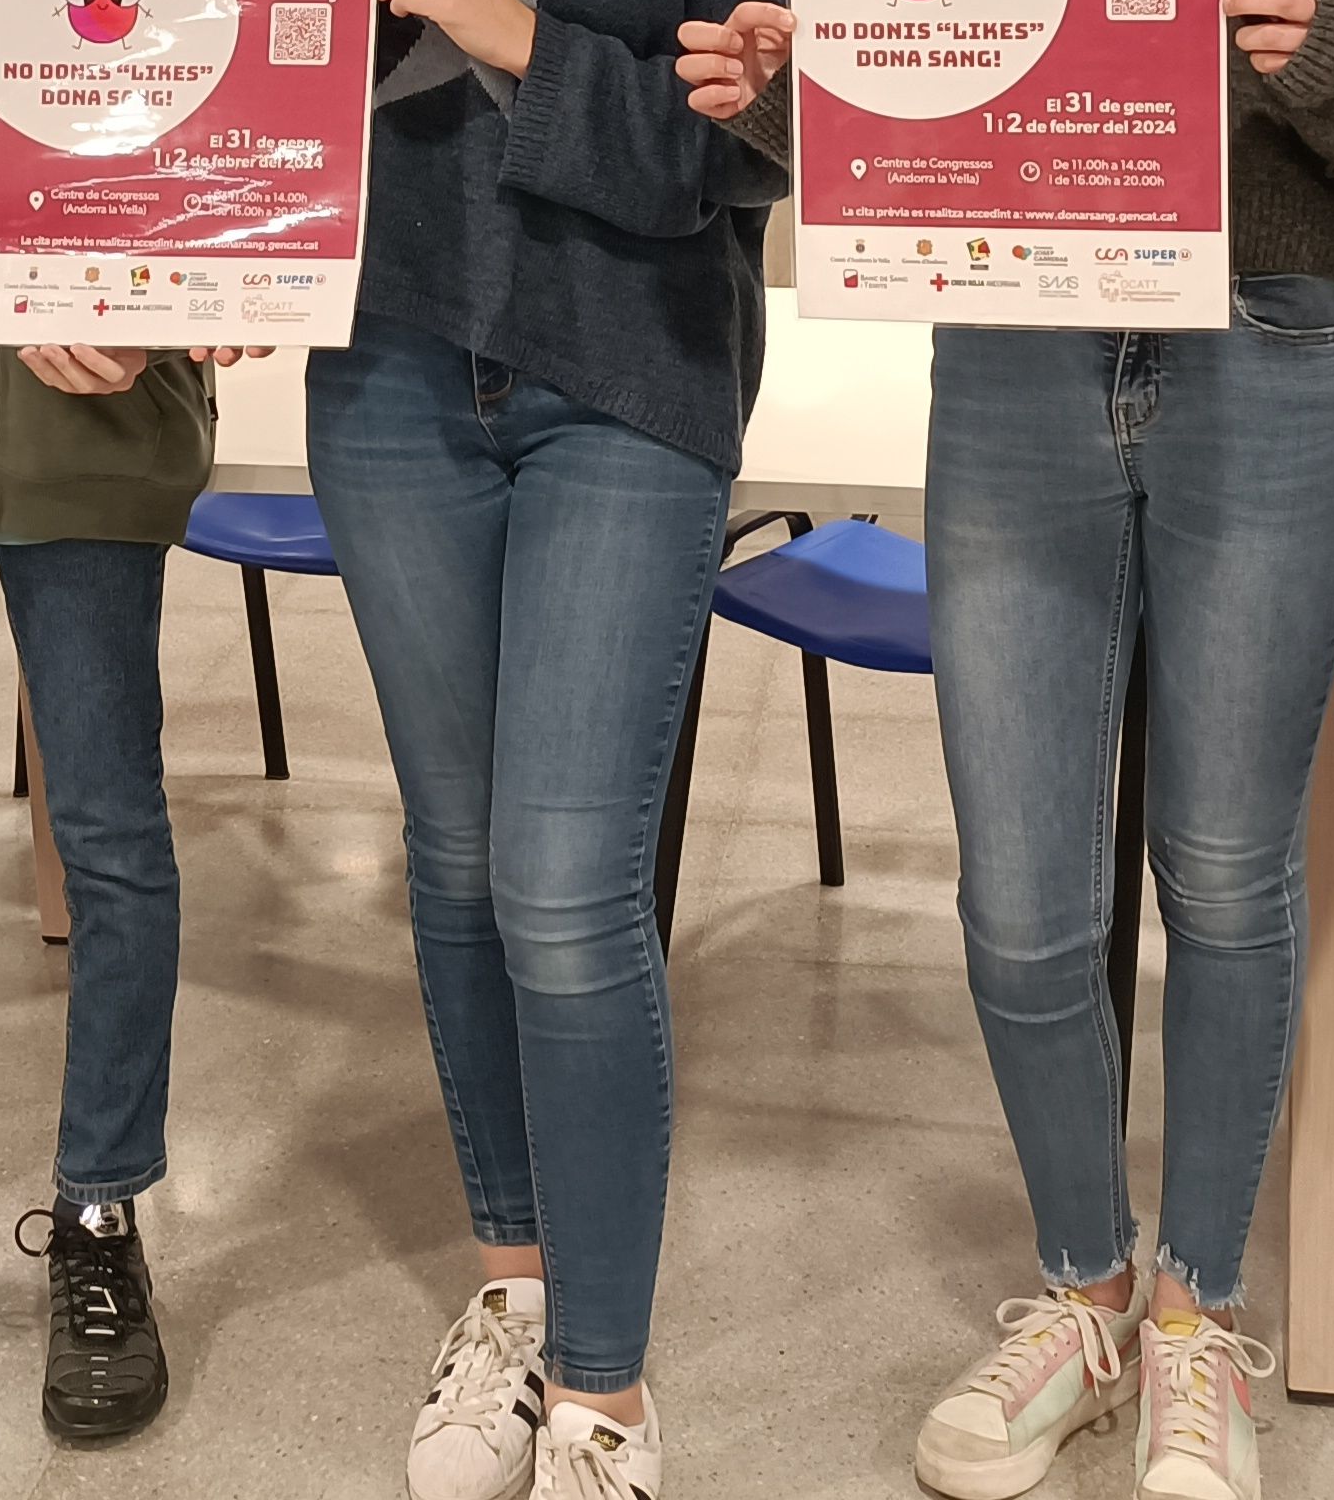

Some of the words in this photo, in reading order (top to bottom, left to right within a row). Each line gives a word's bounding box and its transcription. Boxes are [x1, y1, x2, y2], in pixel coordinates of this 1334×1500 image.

[815, 23, 846, 40] NO
[853, 23, 931, 41] DONIS
[856, 50, 922, 67] DONA
[928, 50, 1001, 68] SANG!
[3, 63, 33, 79] NO
[40, 64, 111, 80] DONIS
[41, 89, 101, 105] DONA
[1046, 98, 1062, 112] El
[1065, 92, 1092, 113] 31
[1099, 97, 1120, 113] de
[1123, 100, 1176, 116] gener,
[983, 112, 994, 134] 1
[1006, 112, 1023, 134] 2
[1026, 119, 1047, 134] de
[1050, 119, 1100, 134] febrer
[1103, 119, 1129, 134] del
[1132, 120, 1177, 135] 2024
[210, 135, 223, 148] El
[226, 129, 251, 148] 31
[257, 136, 275, 148] de
[153, 148, 161, 167] 1
[174, 148, 187, 167] 2
[874, 157, 908, 169] Centre
[911, 157, 927, 169] de
[928, 158, 993, 172] Congressos
[1052, 159, 1070, 171] De
[1071, 159, 1109, 171] 11.00h
[1111, 162, 1119, 171] a
[1121, 160, 1160, 172] 14.00h
[887, 172, 936, 185] (Andorra
[937, 172, 947, 184] la
[949, 173, 980, 186] Vella)
[1054, 174, 1070, 186] de
[1072, 175, 1112, 186] 16.00h
[1114, 177, 1122, 186] a
[1123, 175, 1164, 187] 20.00h
[51, 189, 84, 200] Centre
[86, 190, 99, 200] de
[102, 190, 159, 202] Congressos
[273, 193, 307, 203] 14.00h
[63, 204, 107, 214] (Andorra
[108, 204, 117, 214] la
[842, 206, 854, 217] La
[856, 206, 874, 217] cita
[911, 210, 923, 218] es
[925, 208, 963, 218] realitza
[966, 209, 1011, 219] accedint
[1025, 210, 1177, 222] www.donarsang.gencat.cat
[21, 236, 32, 245] La
[33, 236, 50, 245] cita
[96, 237, 131, 247] realitza
[133, 238, 173, 247] accedint
[1134, 249, 1176, 260] SUPER
[276, 275, 313, 285] SUPER
